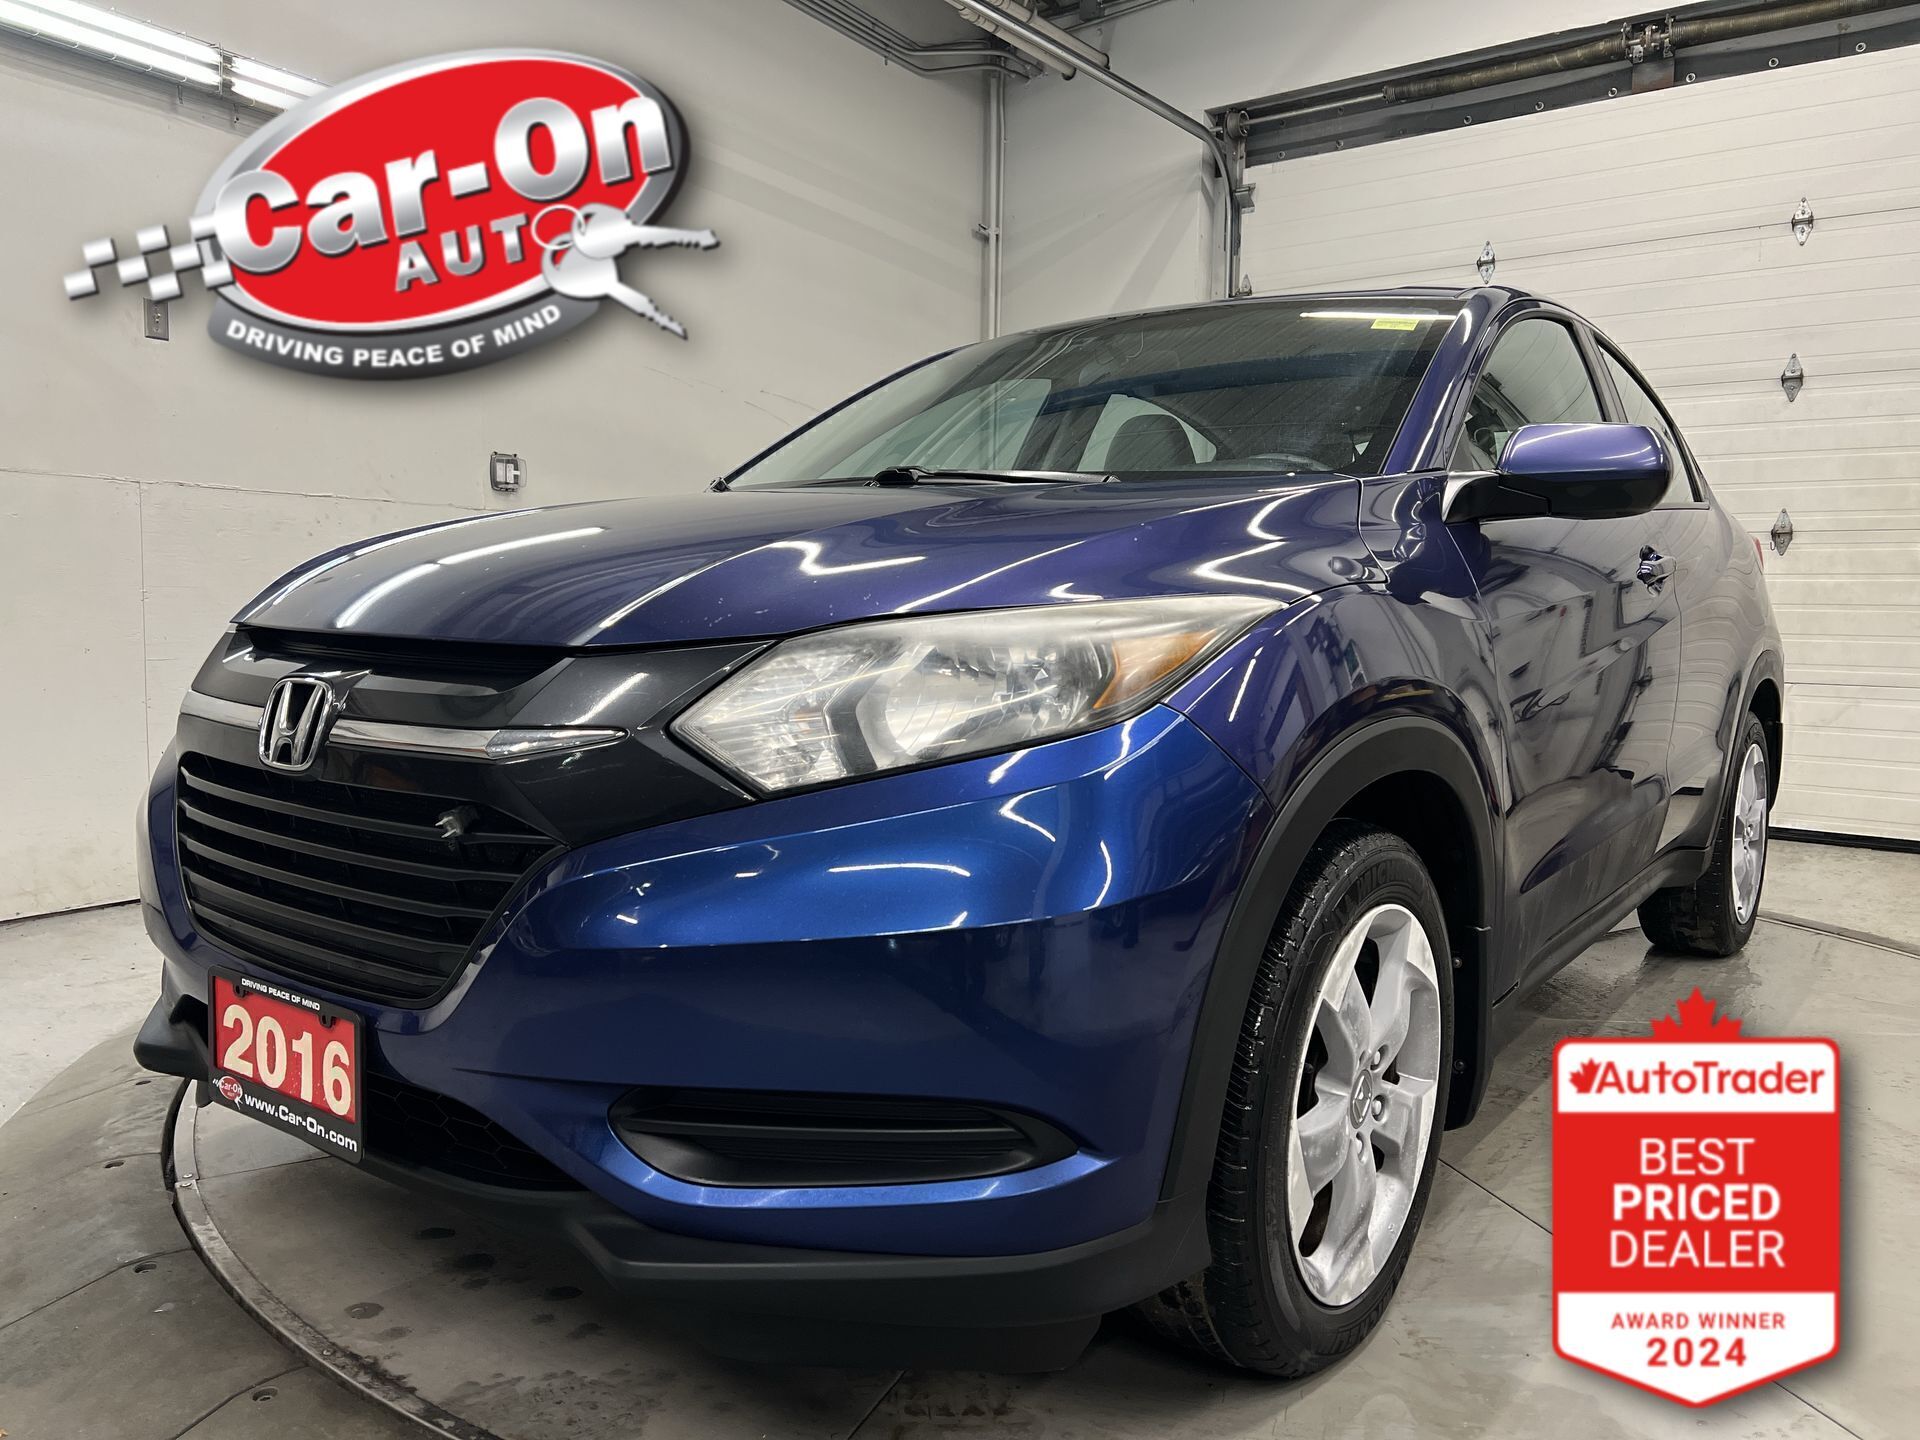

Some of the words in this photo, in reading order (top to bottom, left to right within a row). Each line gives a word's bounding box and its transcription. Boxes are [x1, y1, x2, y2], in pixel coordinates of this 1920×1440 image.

[241, 978, 268, 993] DRIVING
[268, 986, 290, 1001] PEACE
[291, 994, 301, 1004] OF
[301, 998, 320, 1011] MIND
[222, 1004, 352, 1116] 2016
[244, 1093, 358, 1152] www.Car-On.com
